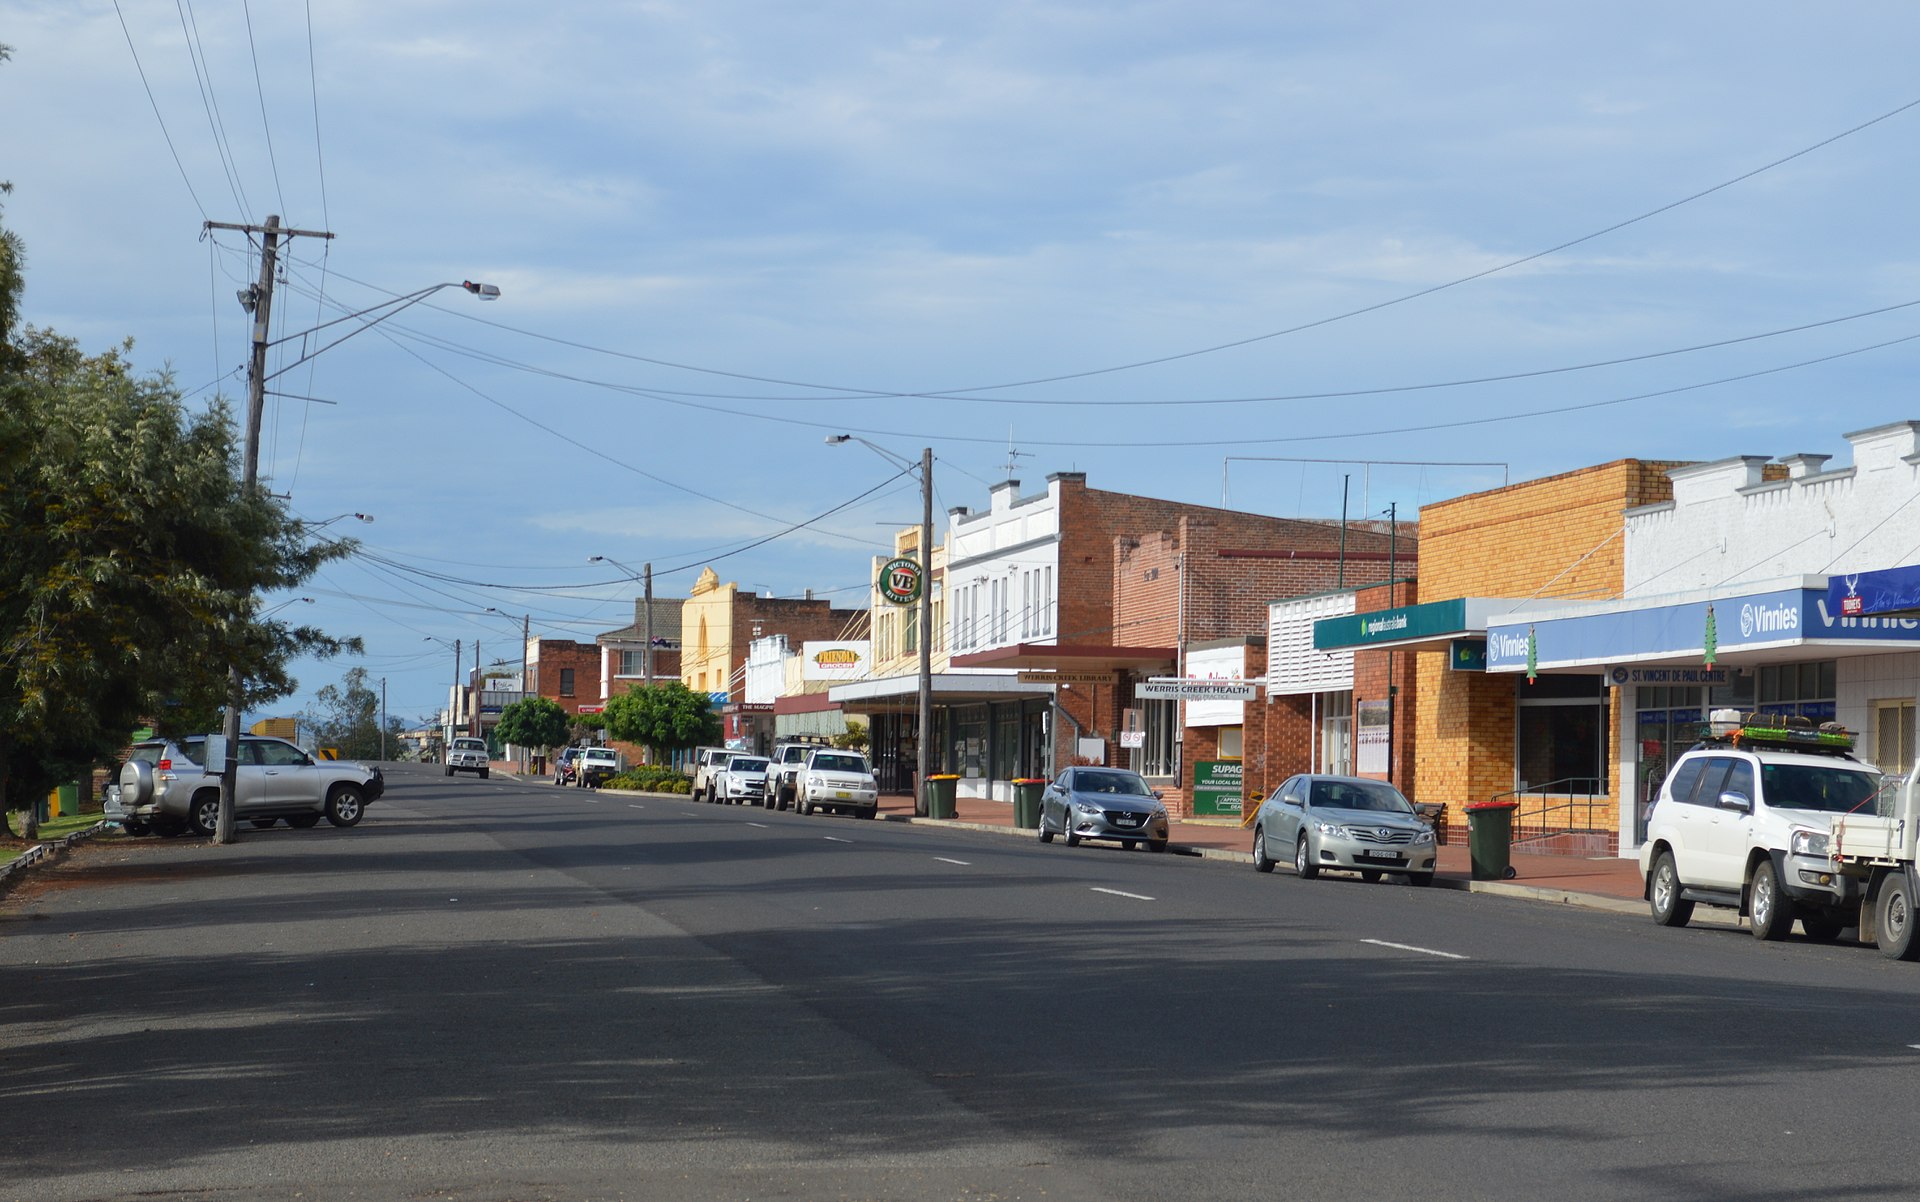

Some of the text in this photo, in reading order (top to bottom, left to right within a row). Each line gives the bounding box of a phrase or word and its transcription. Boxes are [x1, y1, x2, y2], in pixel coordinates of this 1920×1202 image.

[887, 561, 922, 576] VICTORIA
[893, 573, 913, 589] VB
[886, 590, 915, 602] BITTER
[1754, 603, 1798, 632] Vinnies
[1499, 633, 1529, 657] Vinnies
[819, 651, 855, 663] FRIENDLY
[1644, 670, 1671, 682] VINCENT
[1673, 670, 1682, 682] DE
[1683, 670, 1699, 682] PAUL
[1700, 670, 1726, 682] CENTRE
[1145, 685, 1179, 693] WERRIS
[1181, 686, 1210, 694] CREEK
